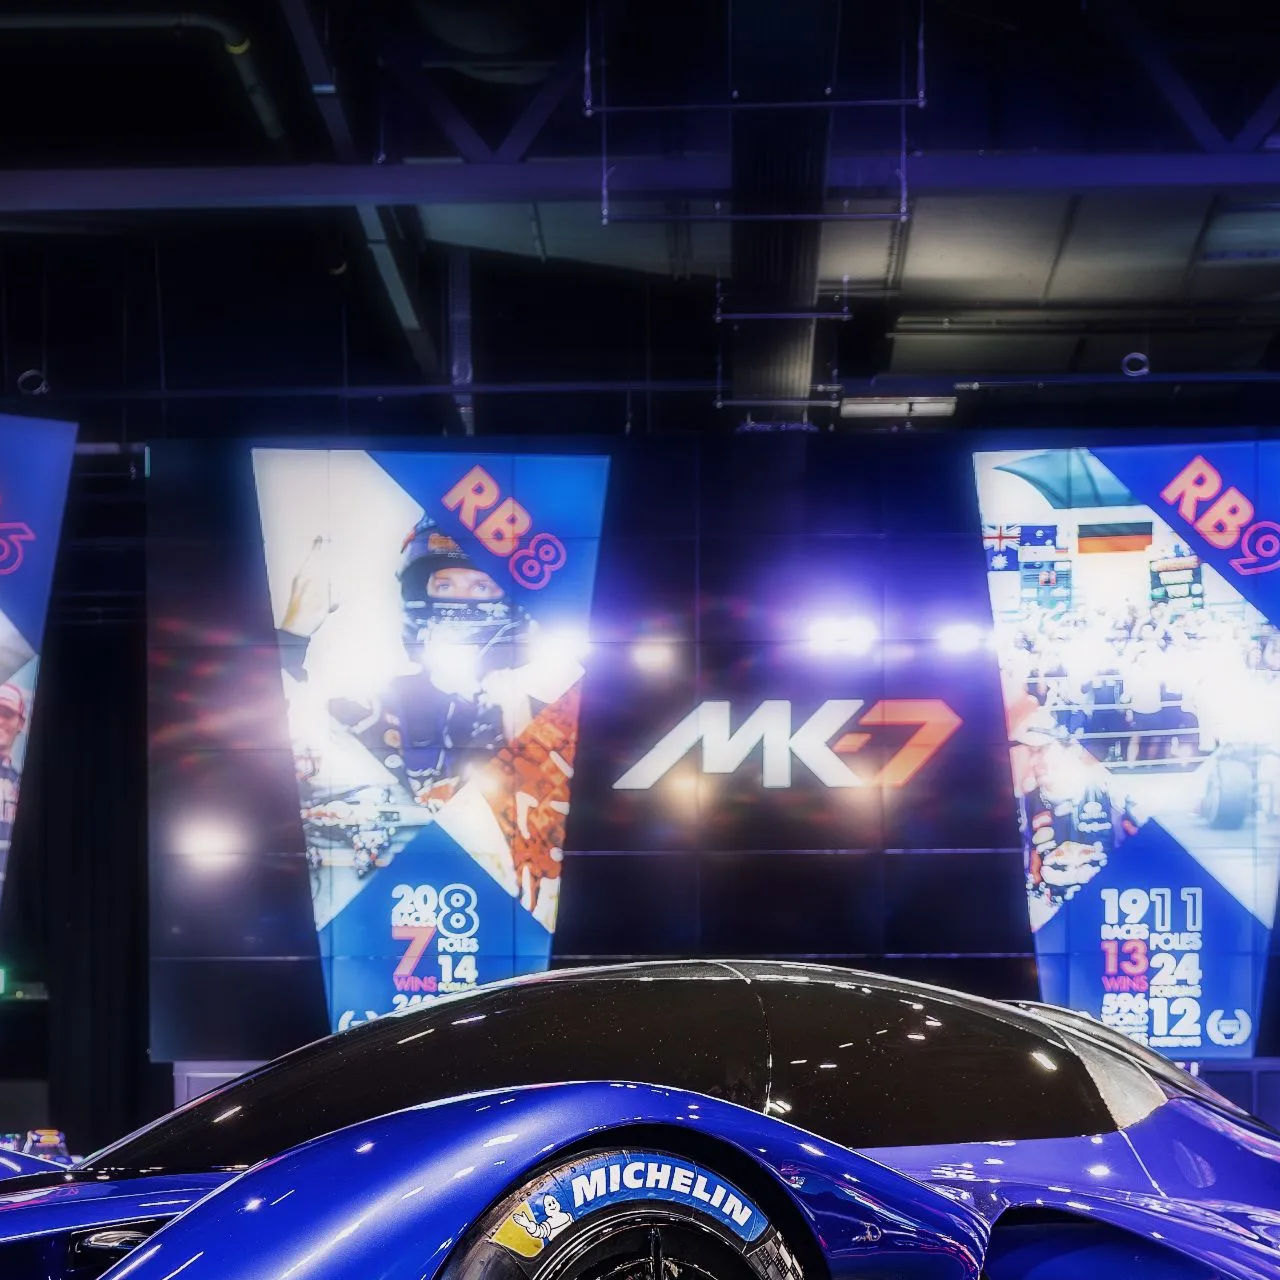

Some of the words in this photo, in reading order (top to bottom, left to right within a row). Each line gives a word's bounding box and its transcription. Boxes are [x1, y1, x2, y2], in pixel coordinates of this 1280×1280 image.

[441, 464, 567, 590] RB8
[391, 884, 439, 914] 20
[436, 883, 480, 938] 8
[1101, 888, 1150, 925] 19
[1149, 887, 1203, 932] 11
[392, 926, 437, 977] 7
[438, 955, 479, 983] 14
[1101, 939, 1150, 976] 13
[1149, 952, 1203, 985] 24
[1149, 998, 1202, 1036] 12
[571, 1161, 753, 1228] MICHELIN
